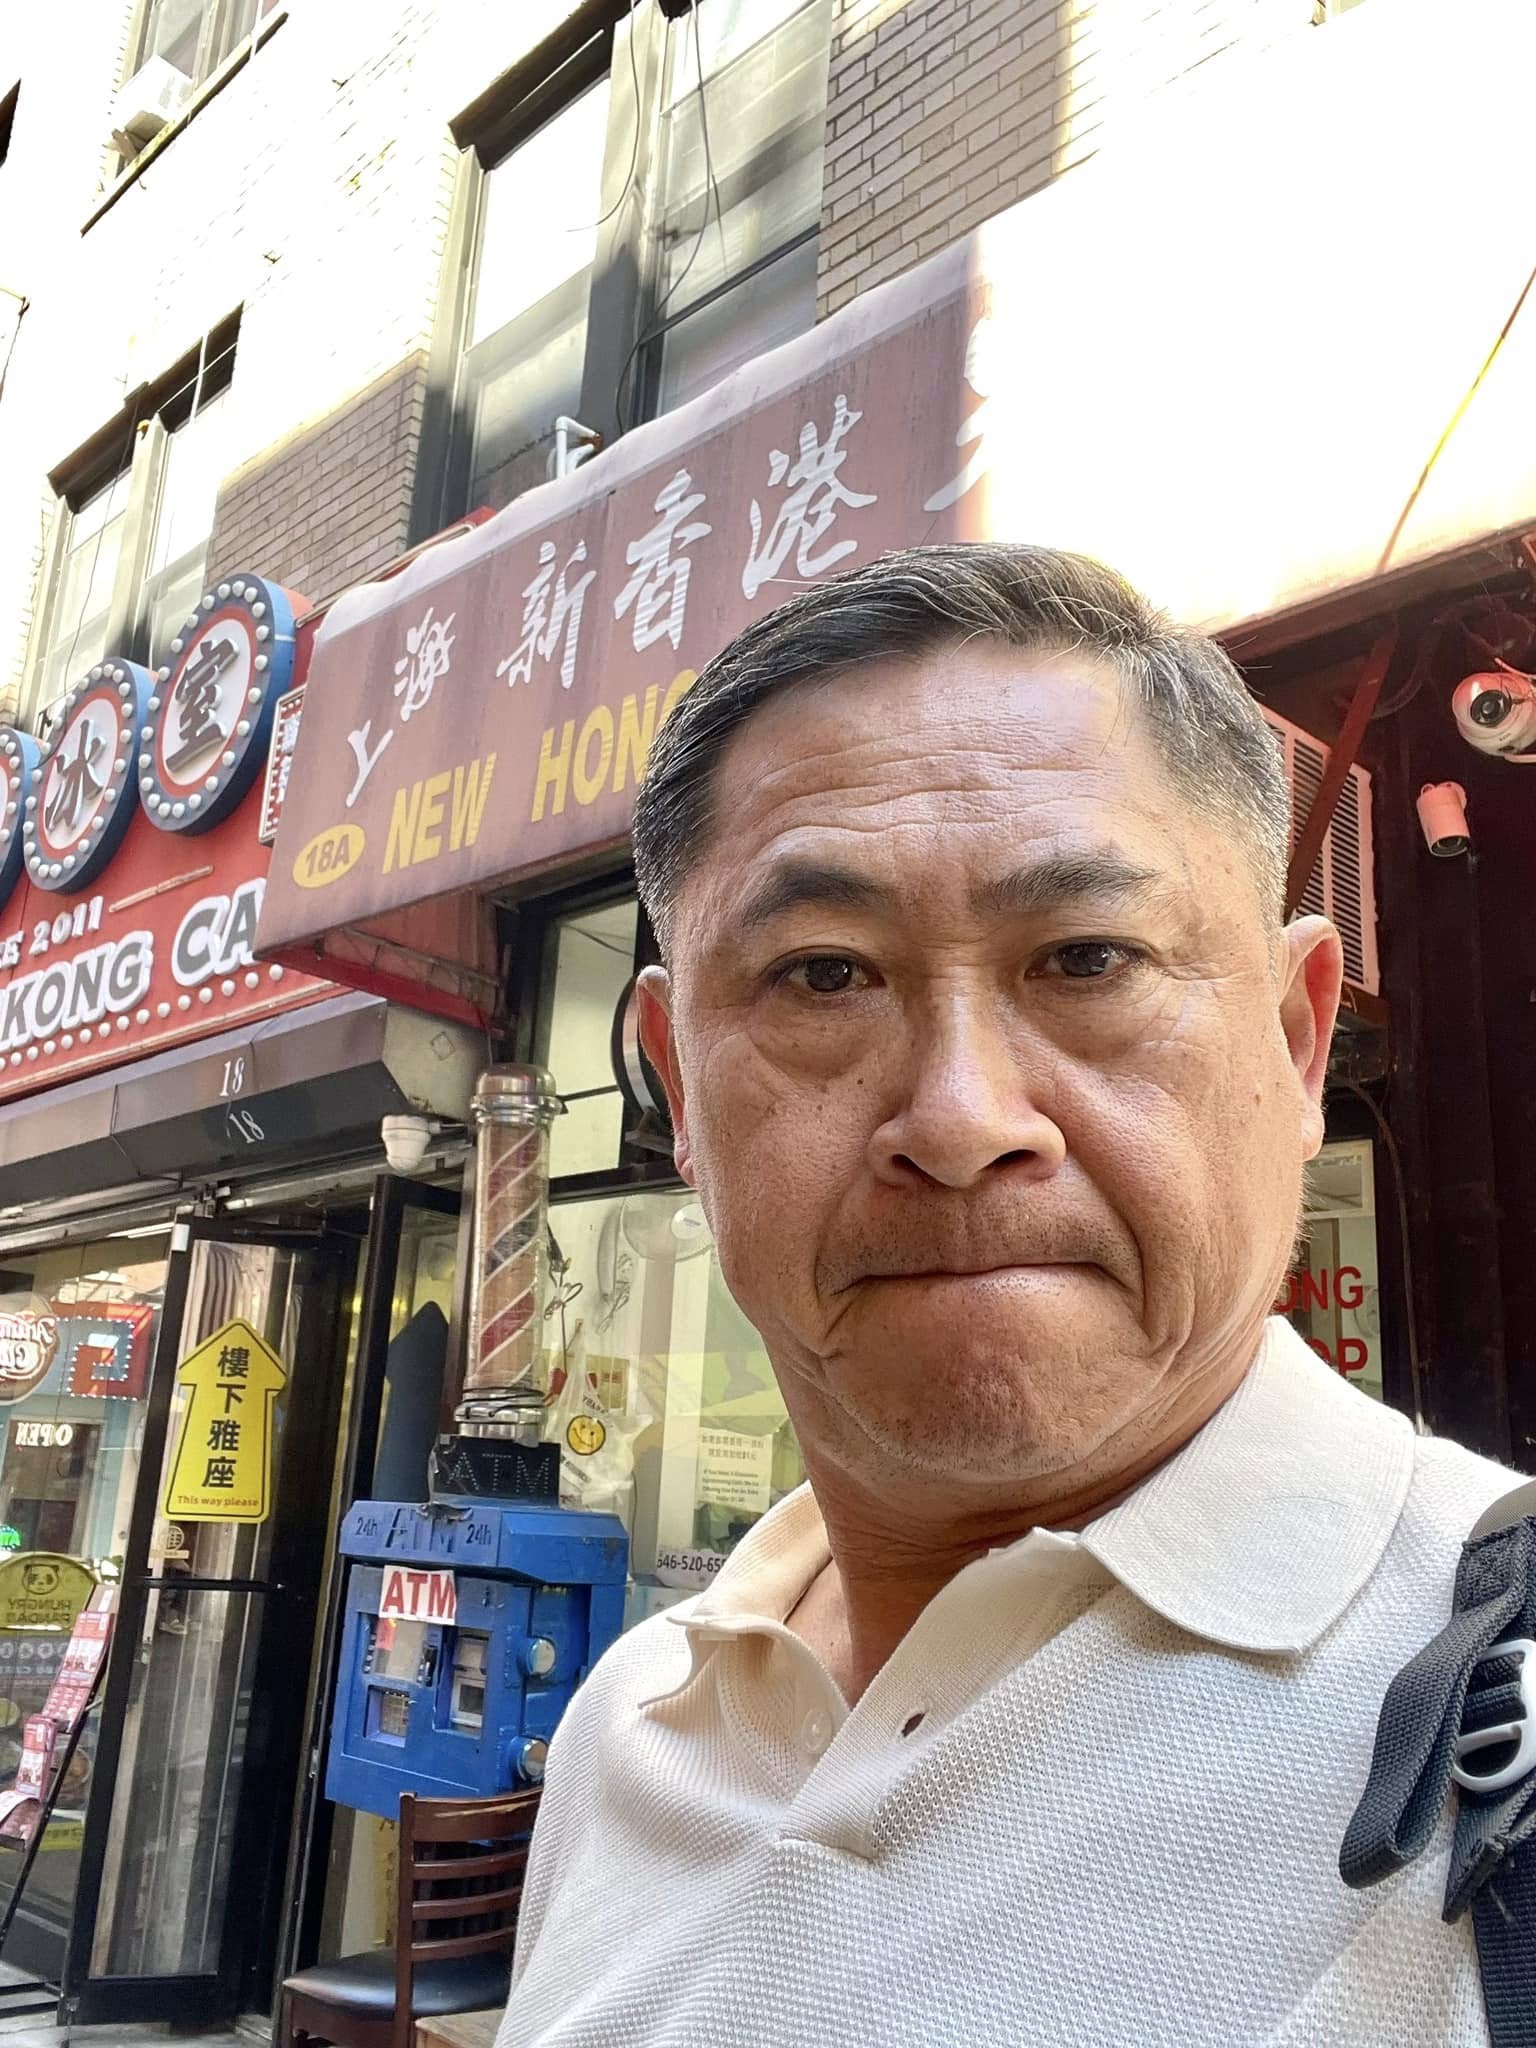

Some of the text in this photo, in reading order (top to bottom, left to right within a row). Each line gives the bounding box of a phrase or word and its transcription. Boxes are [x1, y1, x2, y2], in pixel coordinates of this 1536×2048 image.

[382, 752, 497, 875] NEW
[304, 837, 350, 876] 18A
[29, 895, 104, 957] 2011
[219, 1056, 246, 1097] 18
[229, 1110, 264, 1144] 18
[201, 1345, 250, 1489] 樓下雅座
[446, 1452, 550, 1494] ATM
[177, 1495, 259, 1508] This way please
[355, 1507, 493, 1554] 24h ATM 24h
[382, 1571, 456, 1619] ATM
